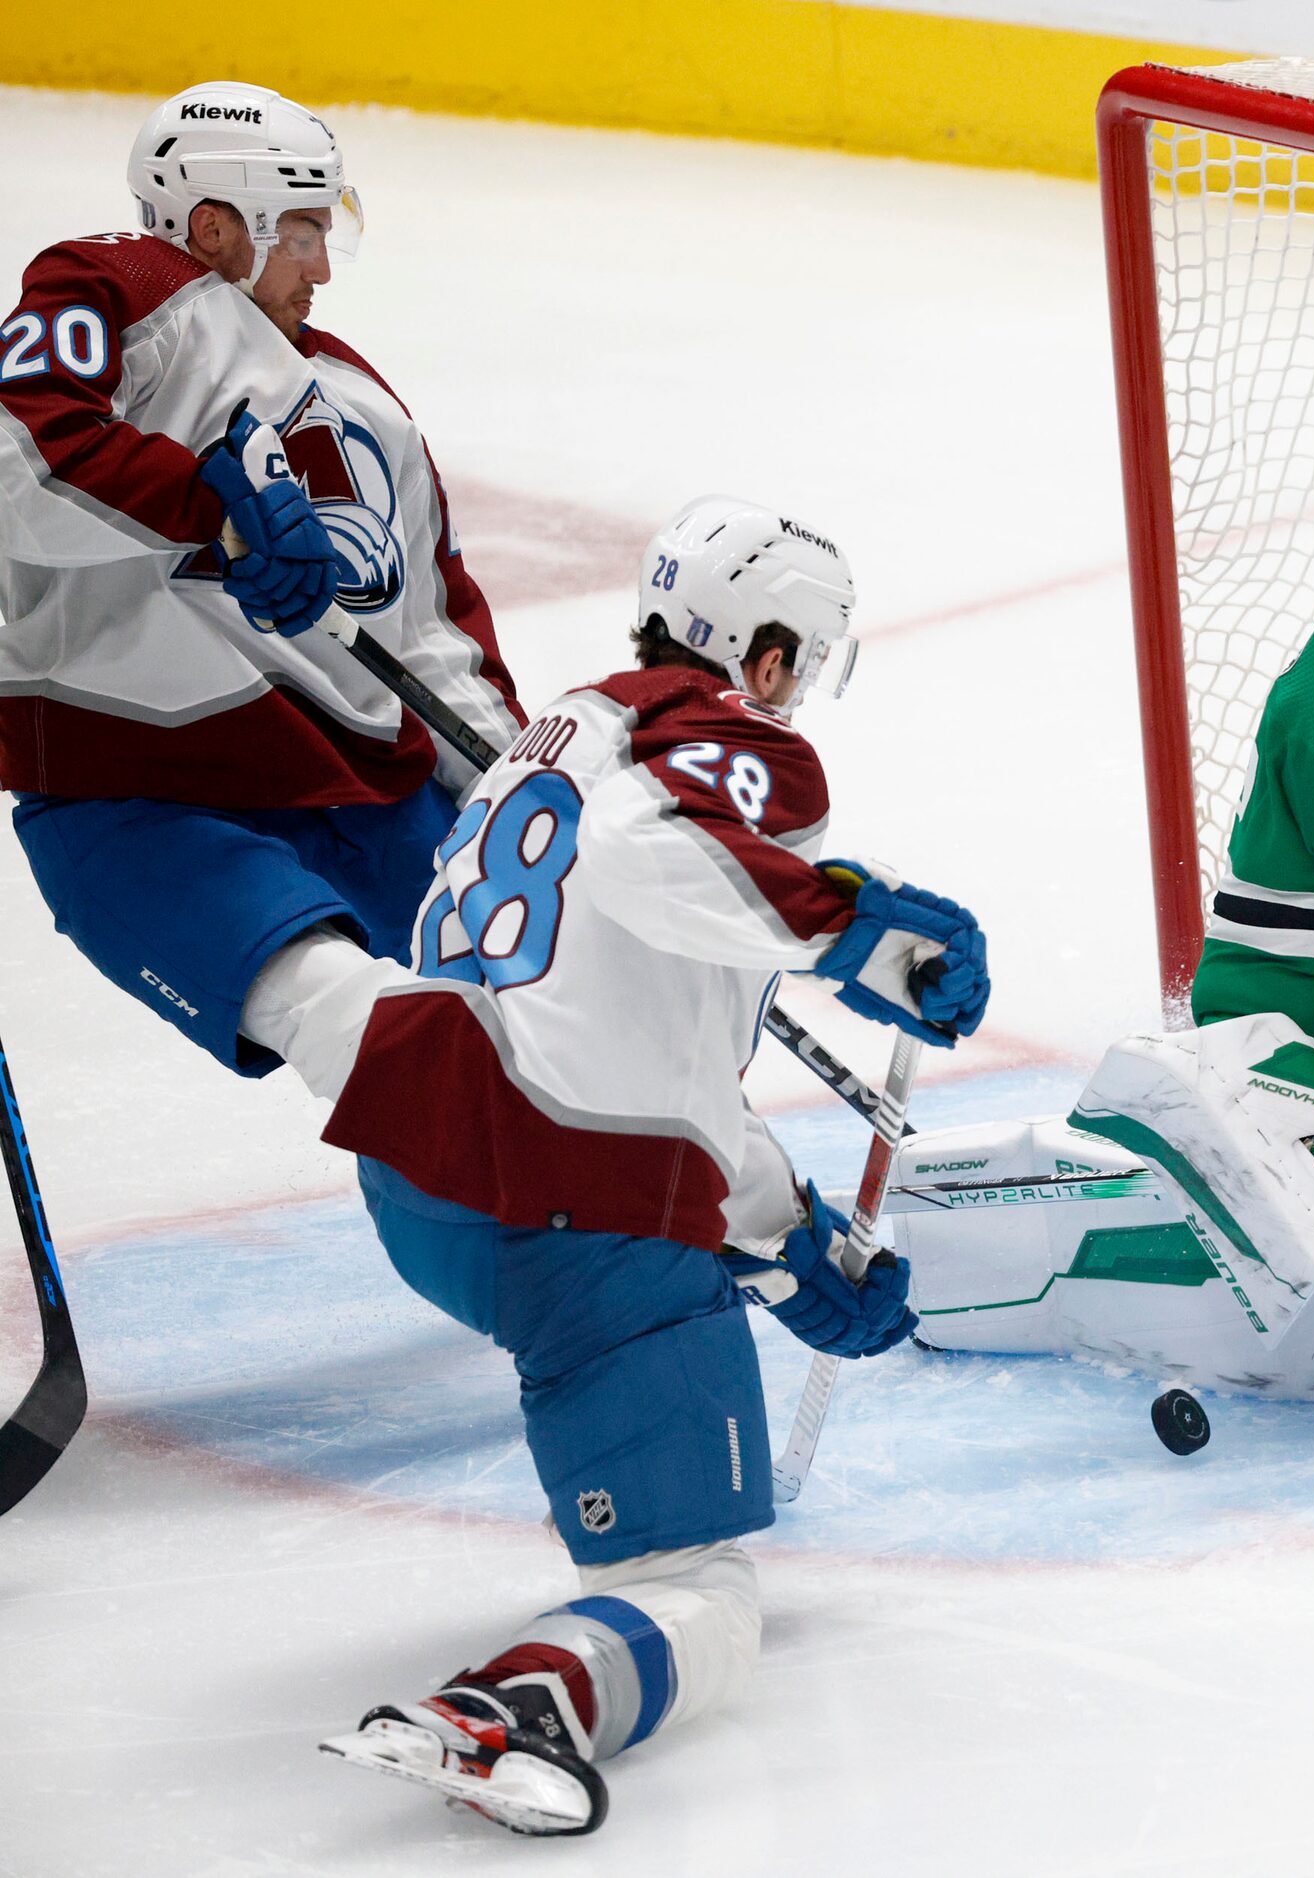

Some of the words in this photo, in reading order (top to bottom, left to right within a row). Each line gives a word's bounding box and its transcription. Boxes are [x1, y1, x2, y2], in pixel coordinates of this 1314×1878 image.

[180, 103, 262, 124] Kiewit
[0, 305, 108, 383] 20
[777, 517, 839, 559] Kiewit
[651, 554, 680, 591] 28
[509, 715, 578, 768] OOD
[666, 741, 772, 825] 28
[140, 966, 199, 1017] CCM
[914, 1159, 989, 1174] SHADOW
[727, 1417, 742, 1493] WARRIOR
[538, 1712, 561, 1738] 28
